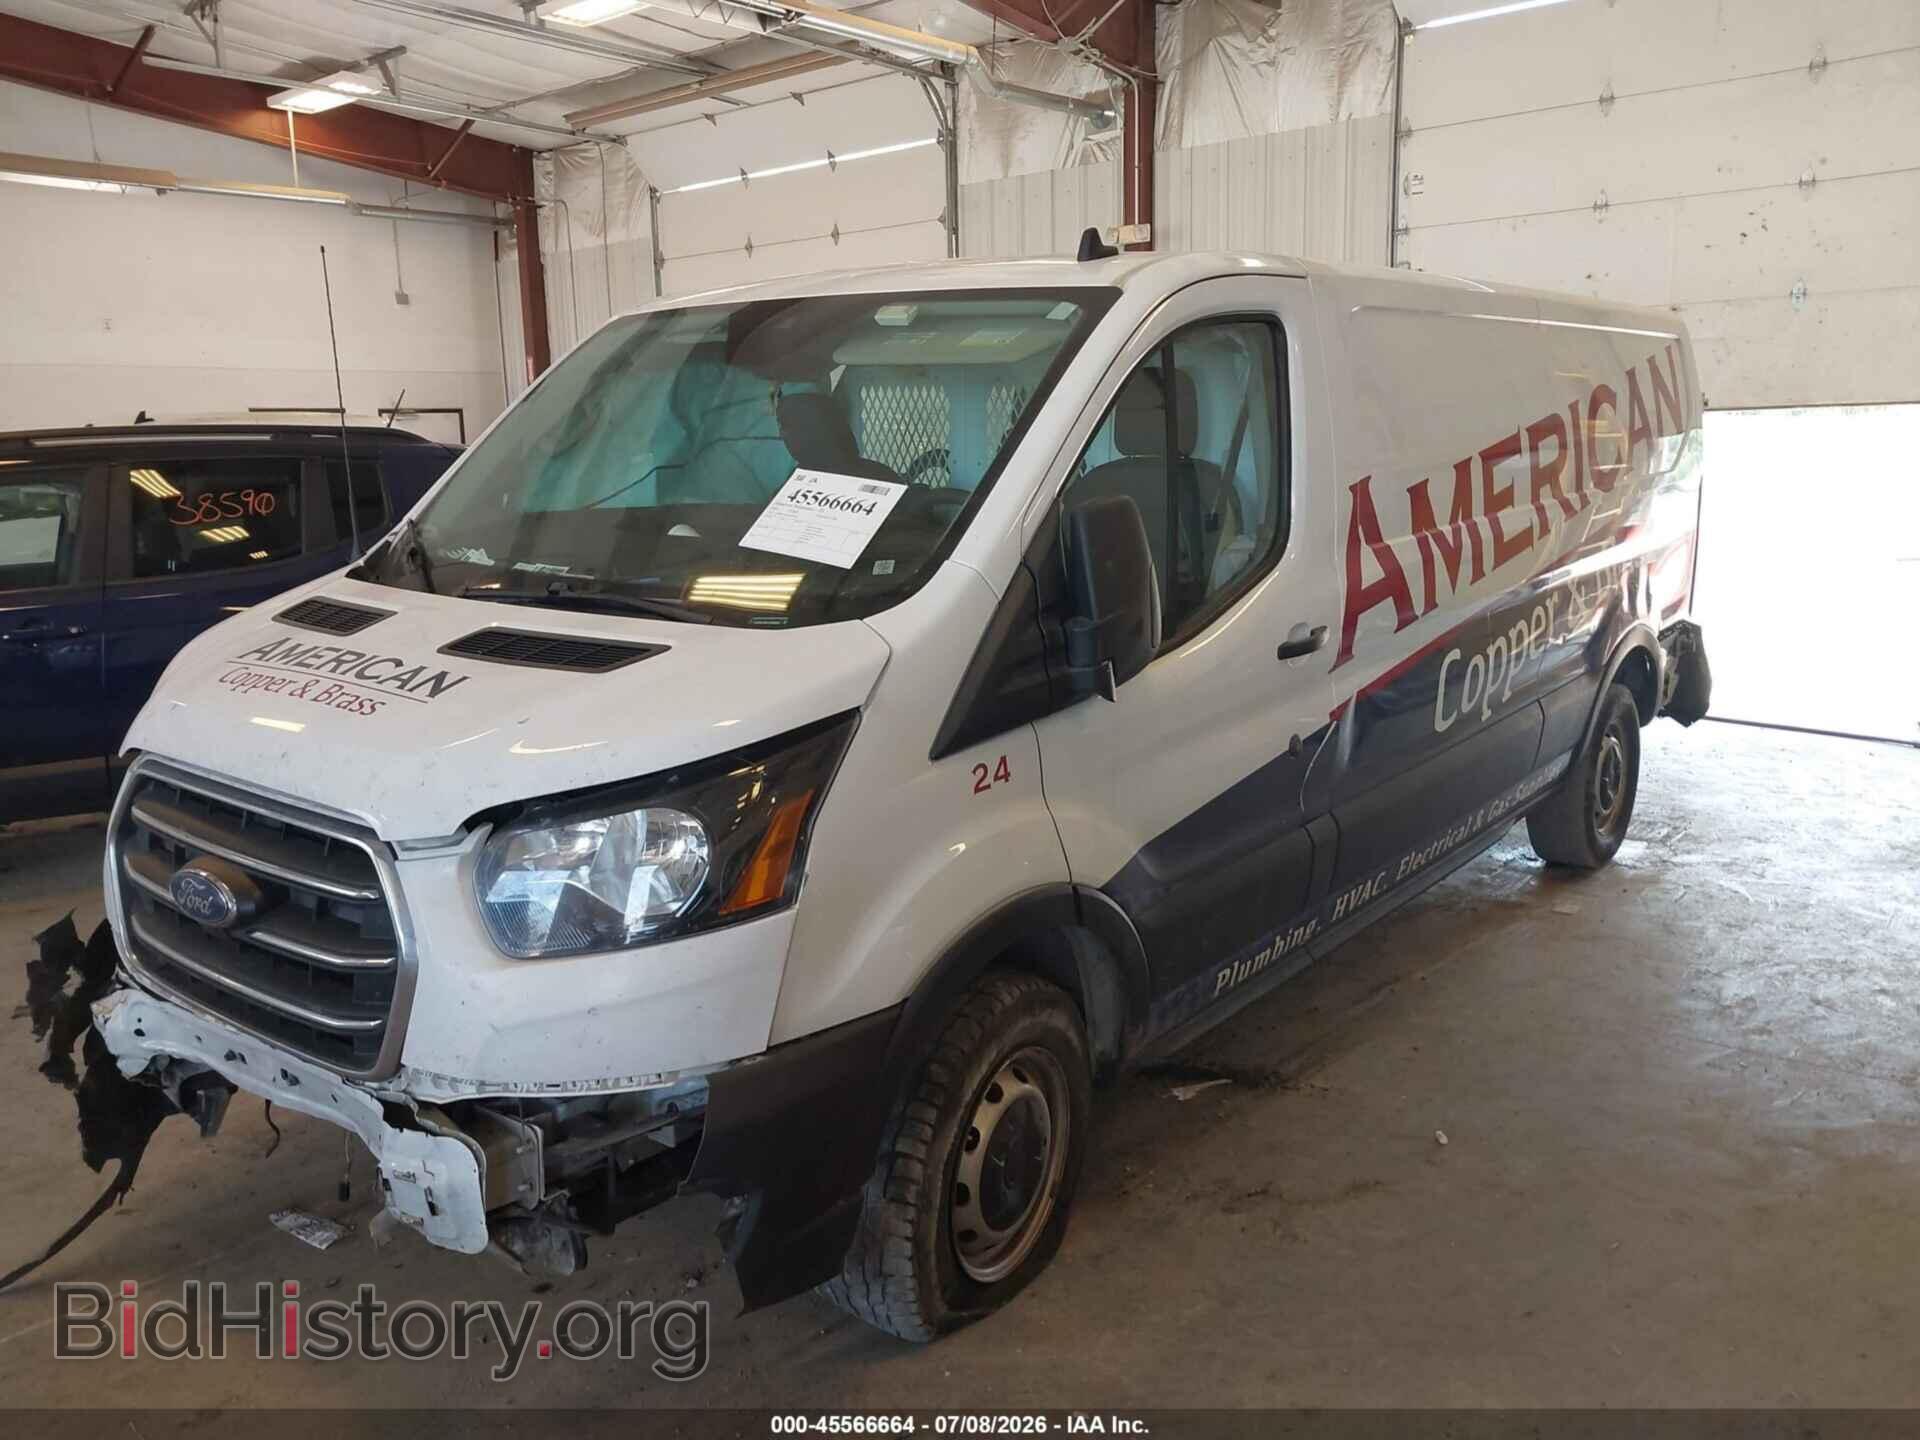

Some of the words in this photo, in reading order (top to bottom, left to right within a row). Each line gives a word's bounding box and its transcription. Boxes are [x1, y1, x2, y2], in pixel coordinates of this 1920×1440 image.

[169, 489, 276, 525] 38590
[787, 488, 878, 516] 45566664
[1328, 344, 1684, 674] AMERICAN
[237, 637, 471, 699] AMERICAN
[1434, 590, 1559, 732] Copper
[219, 667, 294, 695] Copper
[289, 679, 321, 698] &
[311, 684, 387, 716] Brass
[971, 754, 1011, 795] 24
[1395, 816, 1473, 881] Electrical
[176, 878, 215, 915] Ford
